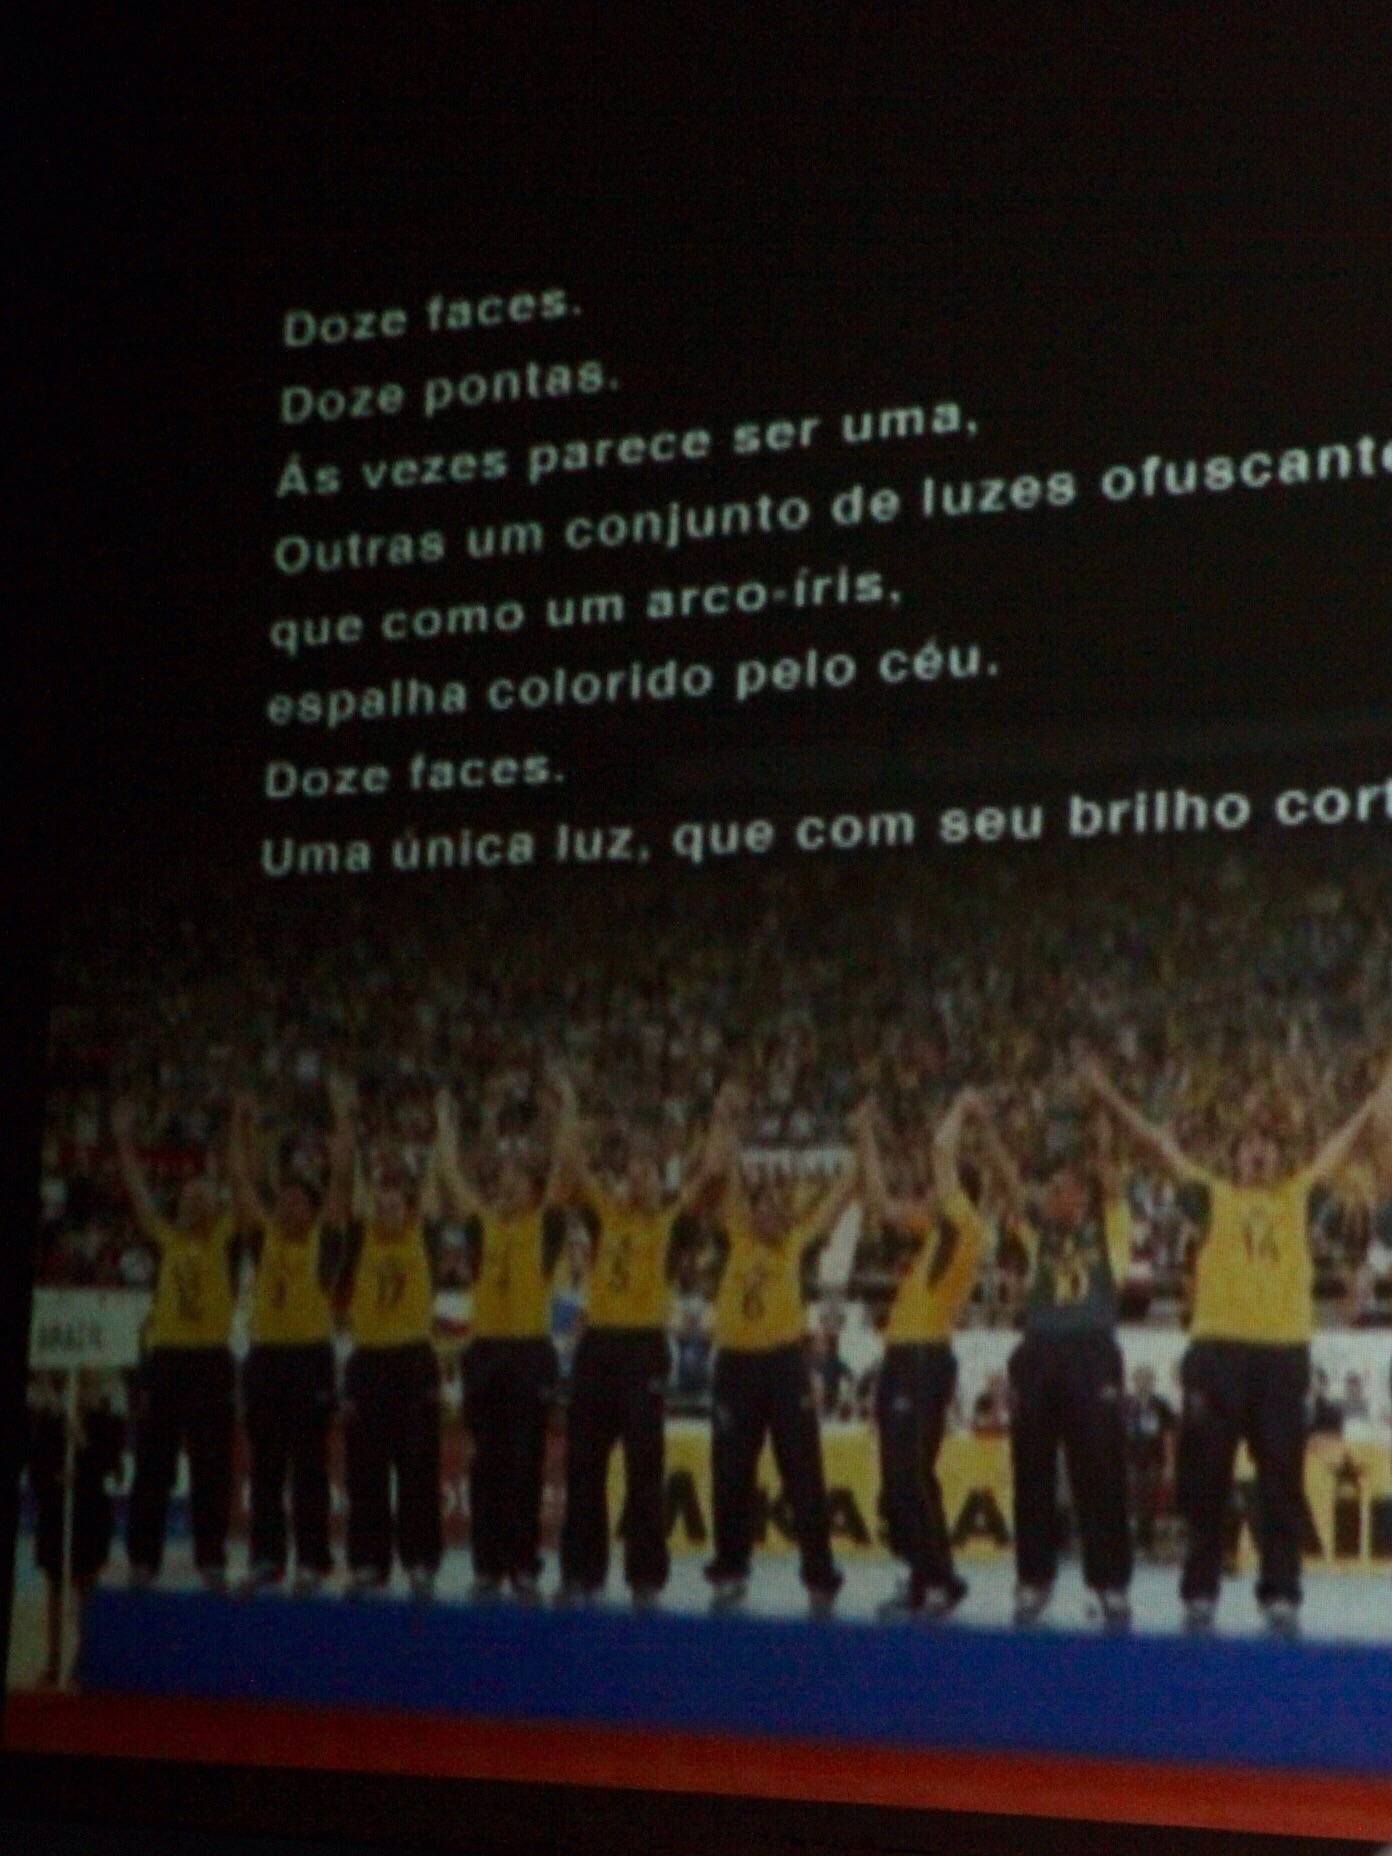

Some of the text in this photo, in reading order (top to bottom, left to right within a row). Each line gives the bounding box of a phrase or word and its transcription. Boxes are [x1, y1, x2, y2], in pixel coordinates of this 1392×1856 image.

[284, 287, 583, 348] Doze faces.
[281, 359, 619, 425] Doze pontas.
[362, 448, 508, 490] vezes
[528, 427, 712, 485] parece
[732, 415, 821, 456] ser
[841, 400, 978, 445] uma,
[273, 530, 446, 575] Outras
[466, 520, 544, 559] um
[564, 492, 812, 550] conjunto
[830, 483, 902, 527] de
[921, 470, 1078, 518] luzes
[269, 614, 364, 657] que
[380, 601, 526, 640] como
[545, 592, 625, 629] um
[266, 636, 999, 730] espalha colorido pelo céu.
[264, 752, 565, 800] Doze faces.
[261, 837, 372, 877] Uma
[391, 825, 535, 871] única
[556, 823, 650, 863] luz,
[671, 818, 776, 865] que
[794, 810, 916, 851] com
[938, 804, 1045, 844] seu
[1067, 787, 1252, 838] brilho
